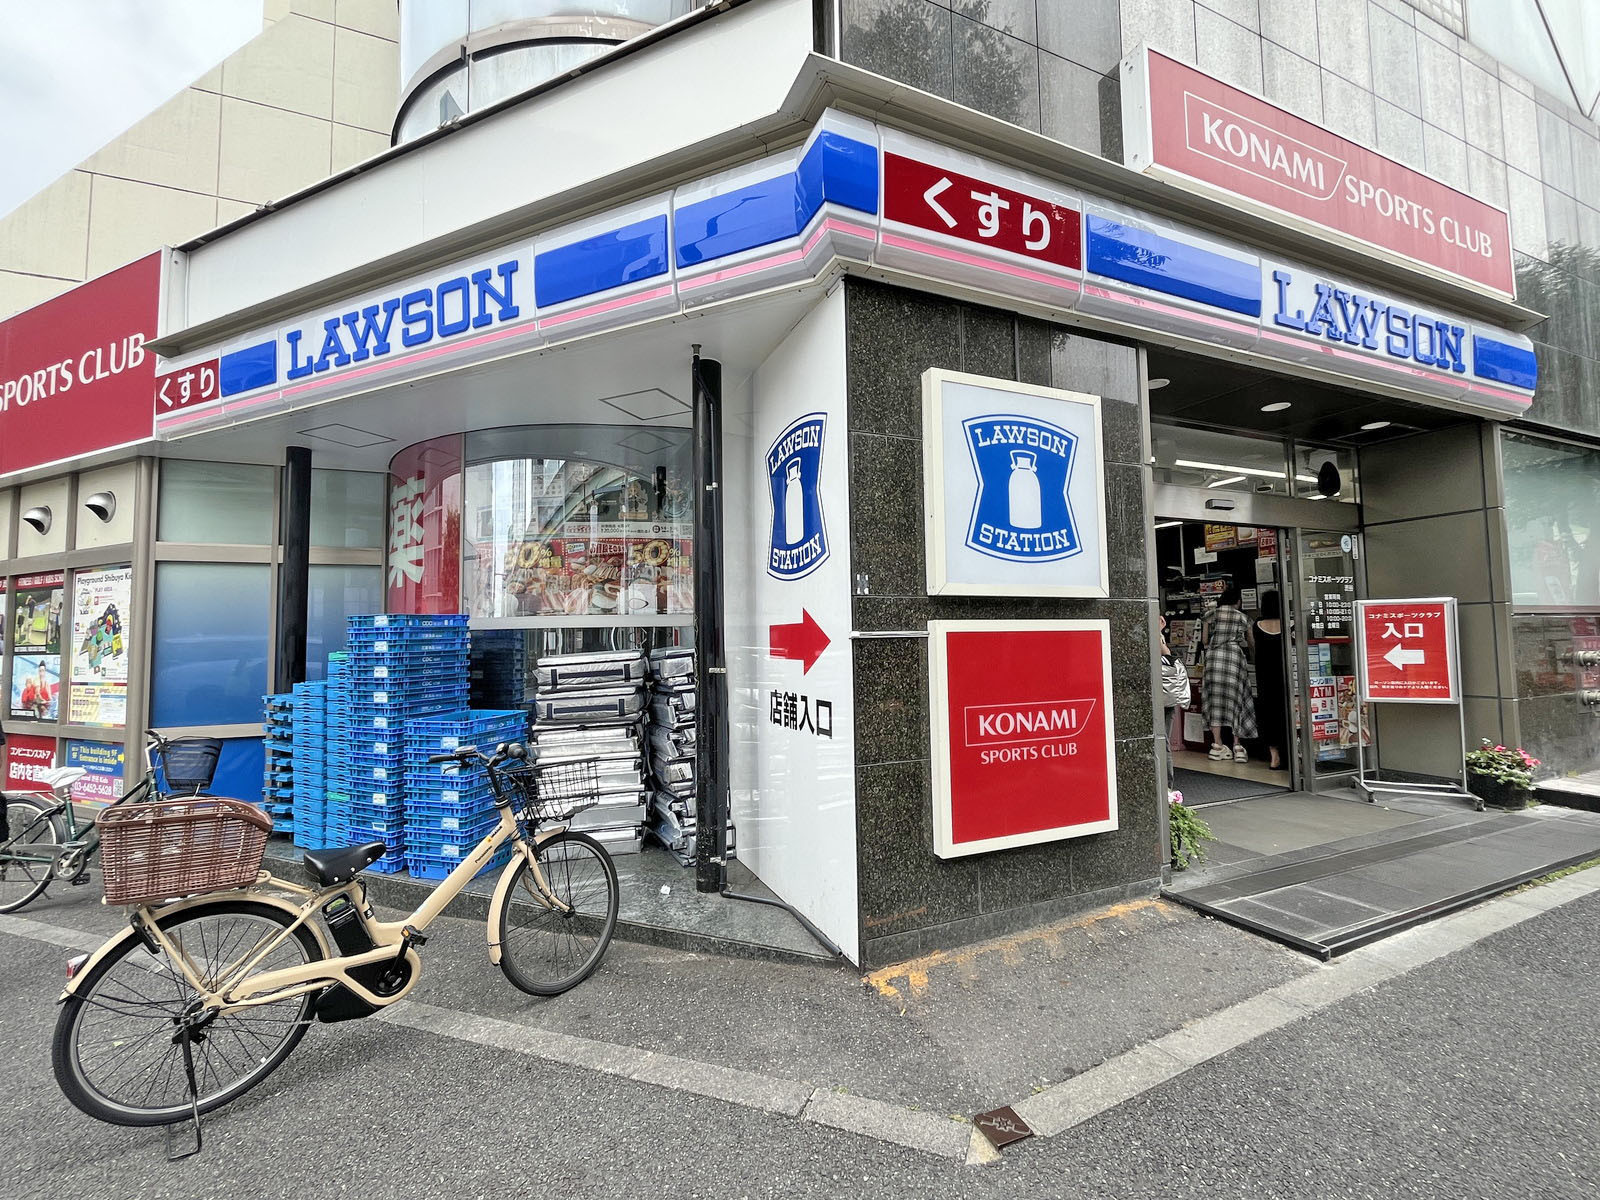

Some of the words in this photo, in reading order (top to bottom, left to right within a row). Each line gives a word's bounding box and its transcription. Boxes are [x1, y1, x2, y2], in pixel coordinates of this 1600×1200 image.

[1202, 112, 1325, 190] KONAMI
[1344, 174, 1435, 235] SPORTS
[1440, 216, 1492, 258] CLUB
[923, 176, 1051, 251] くすり
[286, 259, 519, 380] LAWSON
[1273, 270, 1466, 374] LAWSON
[0, 358, 73, 412] PORTS
[78, 333, 145, 385] CLUB
[158, 367, 215, 408] くすり
[769, 425, 820, 475] LAWSON
[974, 425, 1068, 458] LAWSON
[772, 533, 822, 570] STATION
[978, 523, 1071, 552] STATION
[1368, 611, 1441, 619] コナミスポーツクラブ
[1381, 622, 1424, 639] 入口
[1313, 686, 1332, 698] ATM
[769, 688, 833, 740] 店舗入口
[978, 708, 1077, 737] KONAMI
[980, 746, 1038, 765] SPORTS
[1041, 742, 1078, 758] CLUB
